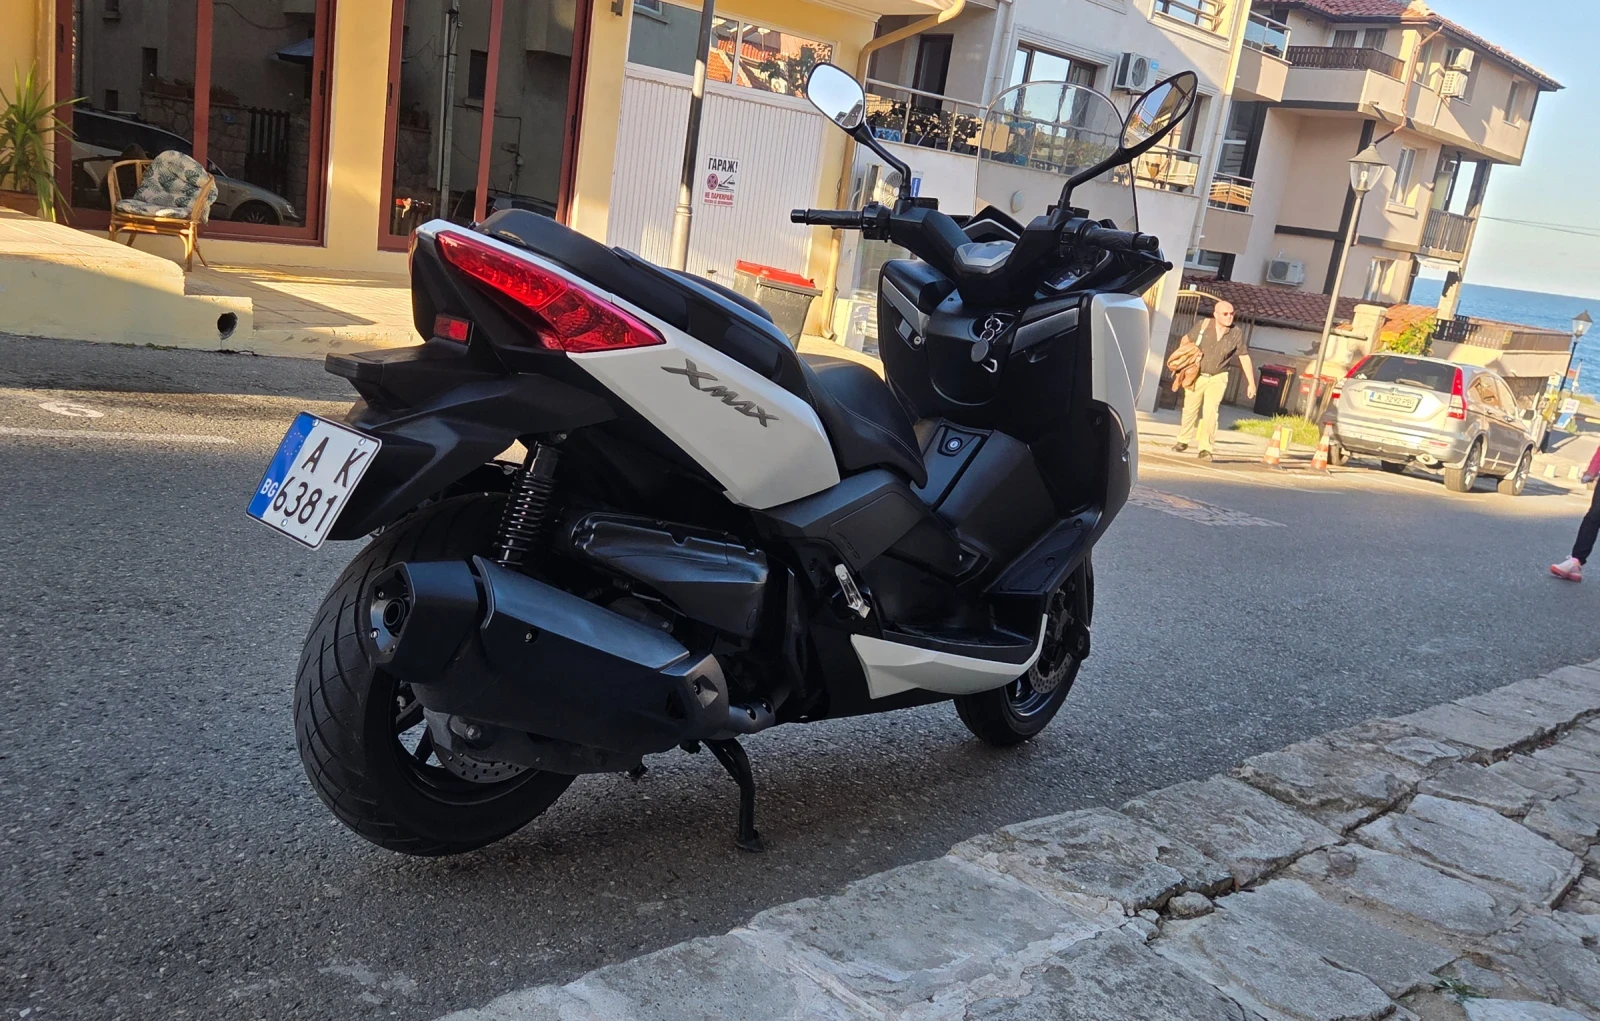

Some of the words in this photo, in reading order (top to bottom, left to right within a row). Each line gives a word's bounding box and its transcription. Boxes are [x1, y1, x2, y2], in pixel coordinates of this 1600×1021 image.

[708, 157, 739, 173] ГАРАЖ!
[301, 436, 330, 474] A
[333, 447, 368, 488] K
[260, 478, 279, 498] BG
[272, 476, 339, 532] 6381
